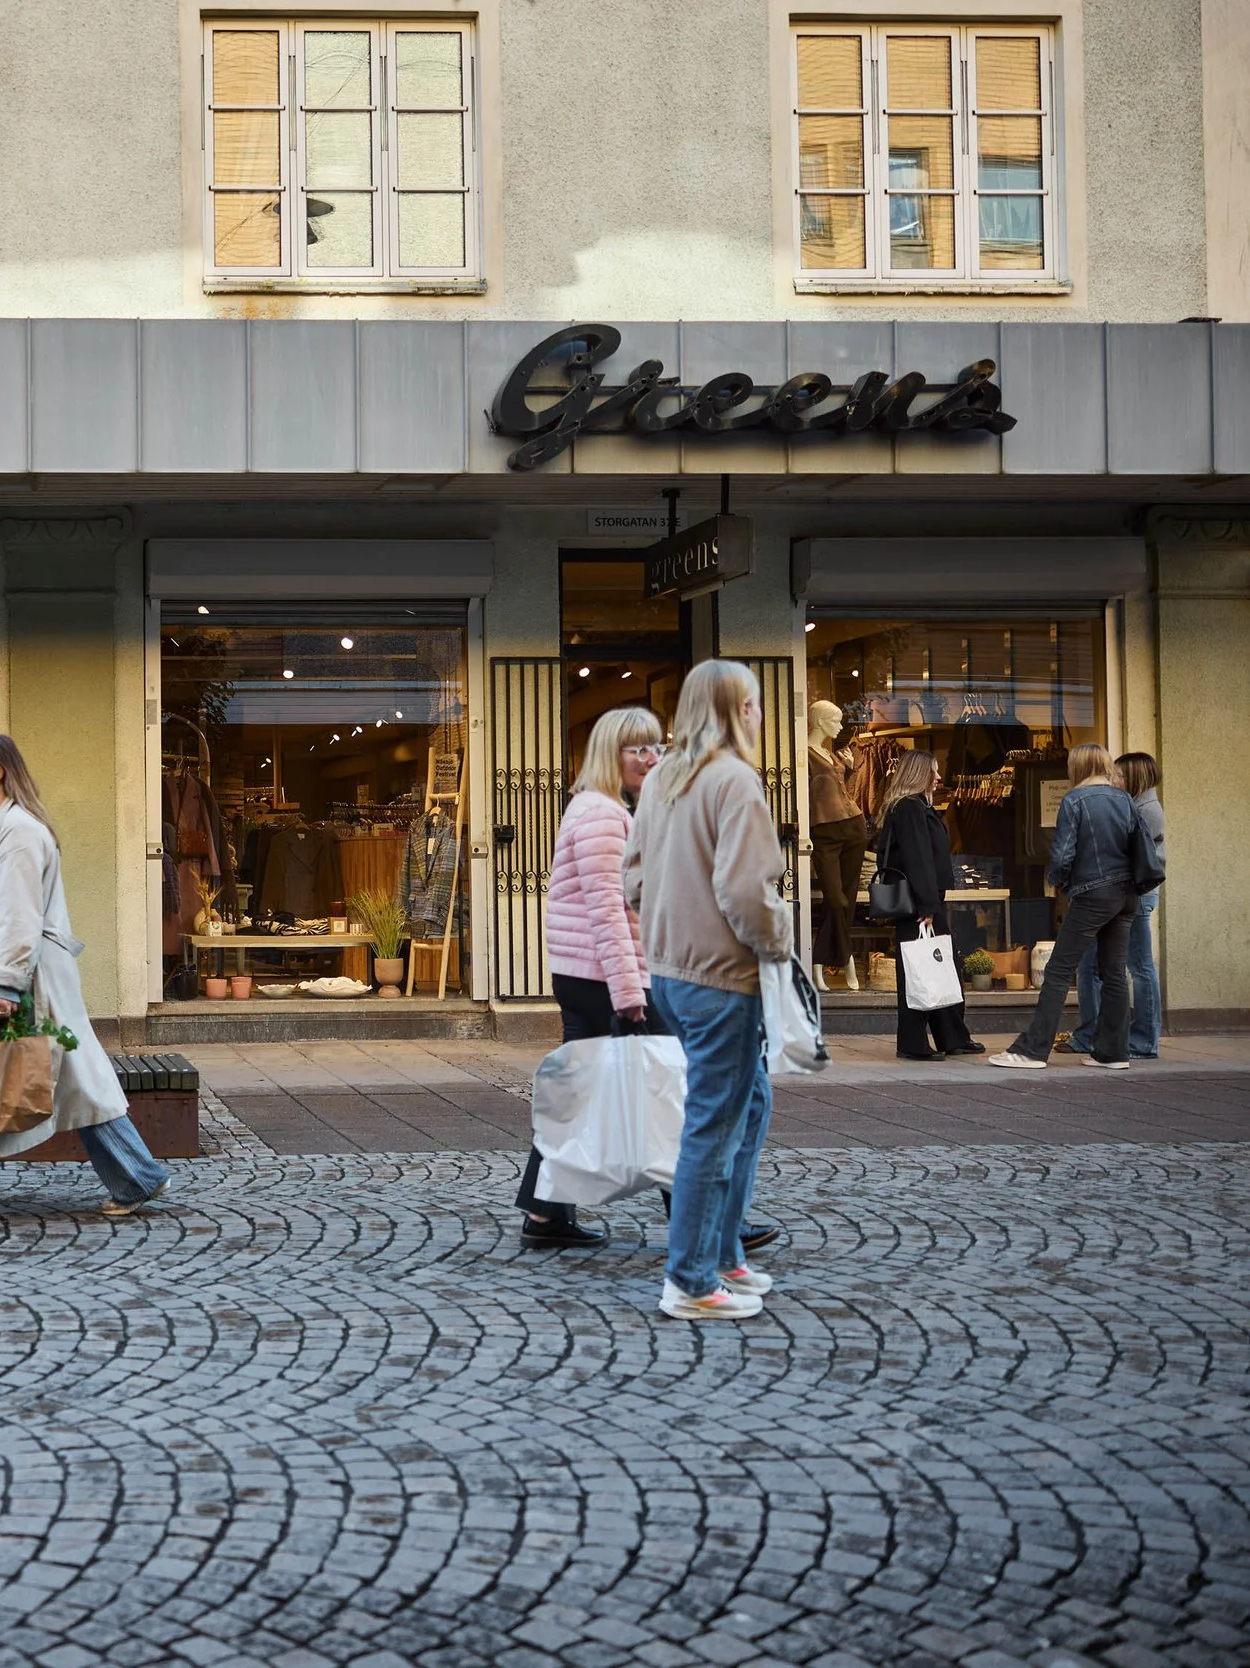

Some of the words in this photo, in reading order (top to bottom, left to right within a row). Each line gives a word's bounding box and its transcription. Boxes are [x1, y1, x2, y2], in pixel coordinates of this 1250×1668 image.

[489, 324, 1018, 471] Greens
[595, 517, 657, 527] STORGATAN
[651, 536, 718, 593] greens
